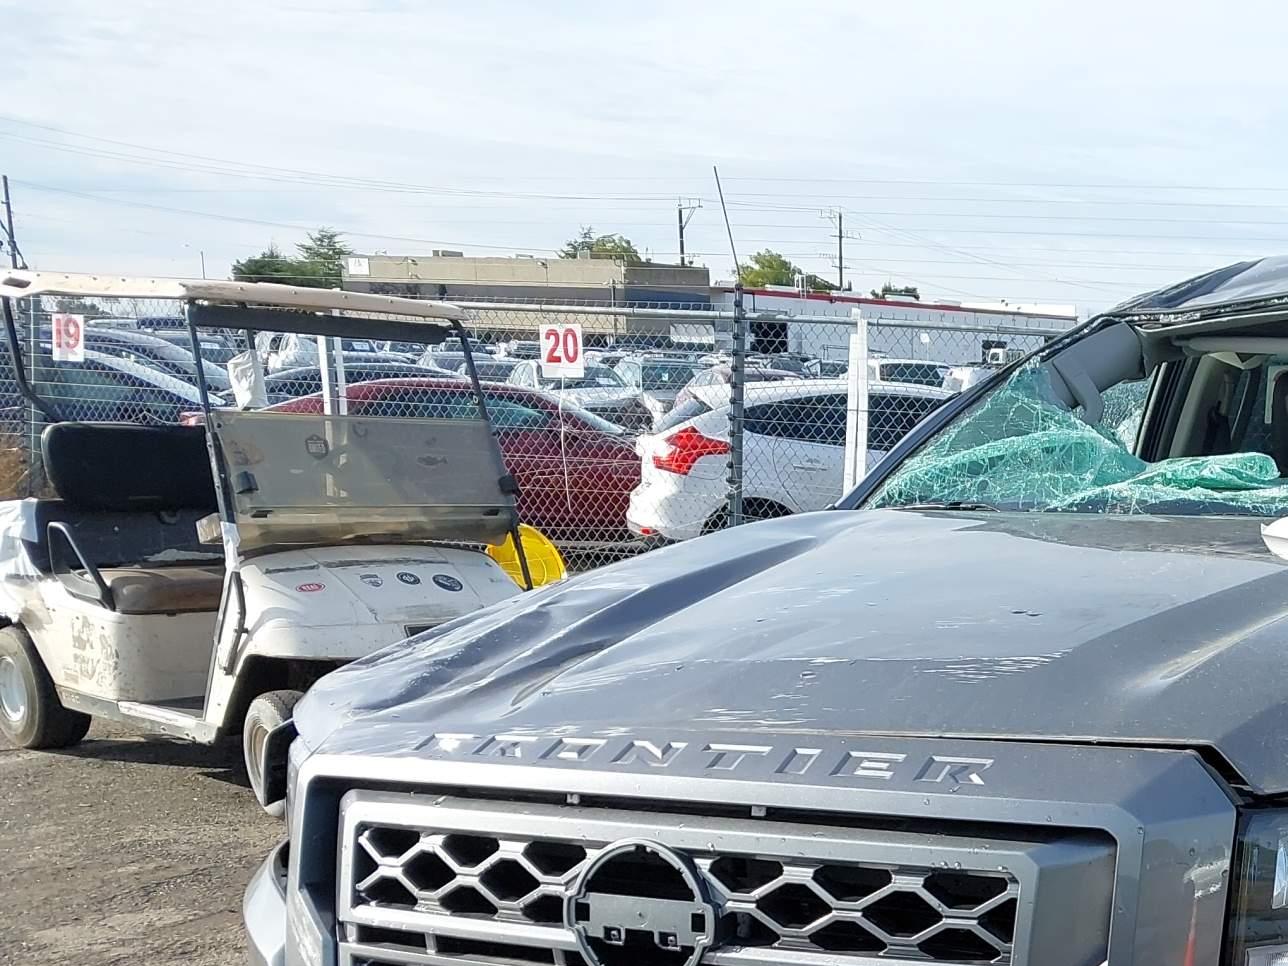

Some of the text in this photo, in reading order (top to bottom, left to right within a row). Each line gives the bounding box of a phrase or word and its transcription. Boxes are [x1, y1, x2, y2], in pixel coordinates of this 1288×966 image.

[55, 317, 80, 349] 19
[545, 328, 578, 363] 20
[414, 733, 994, 786] FRONTIER
